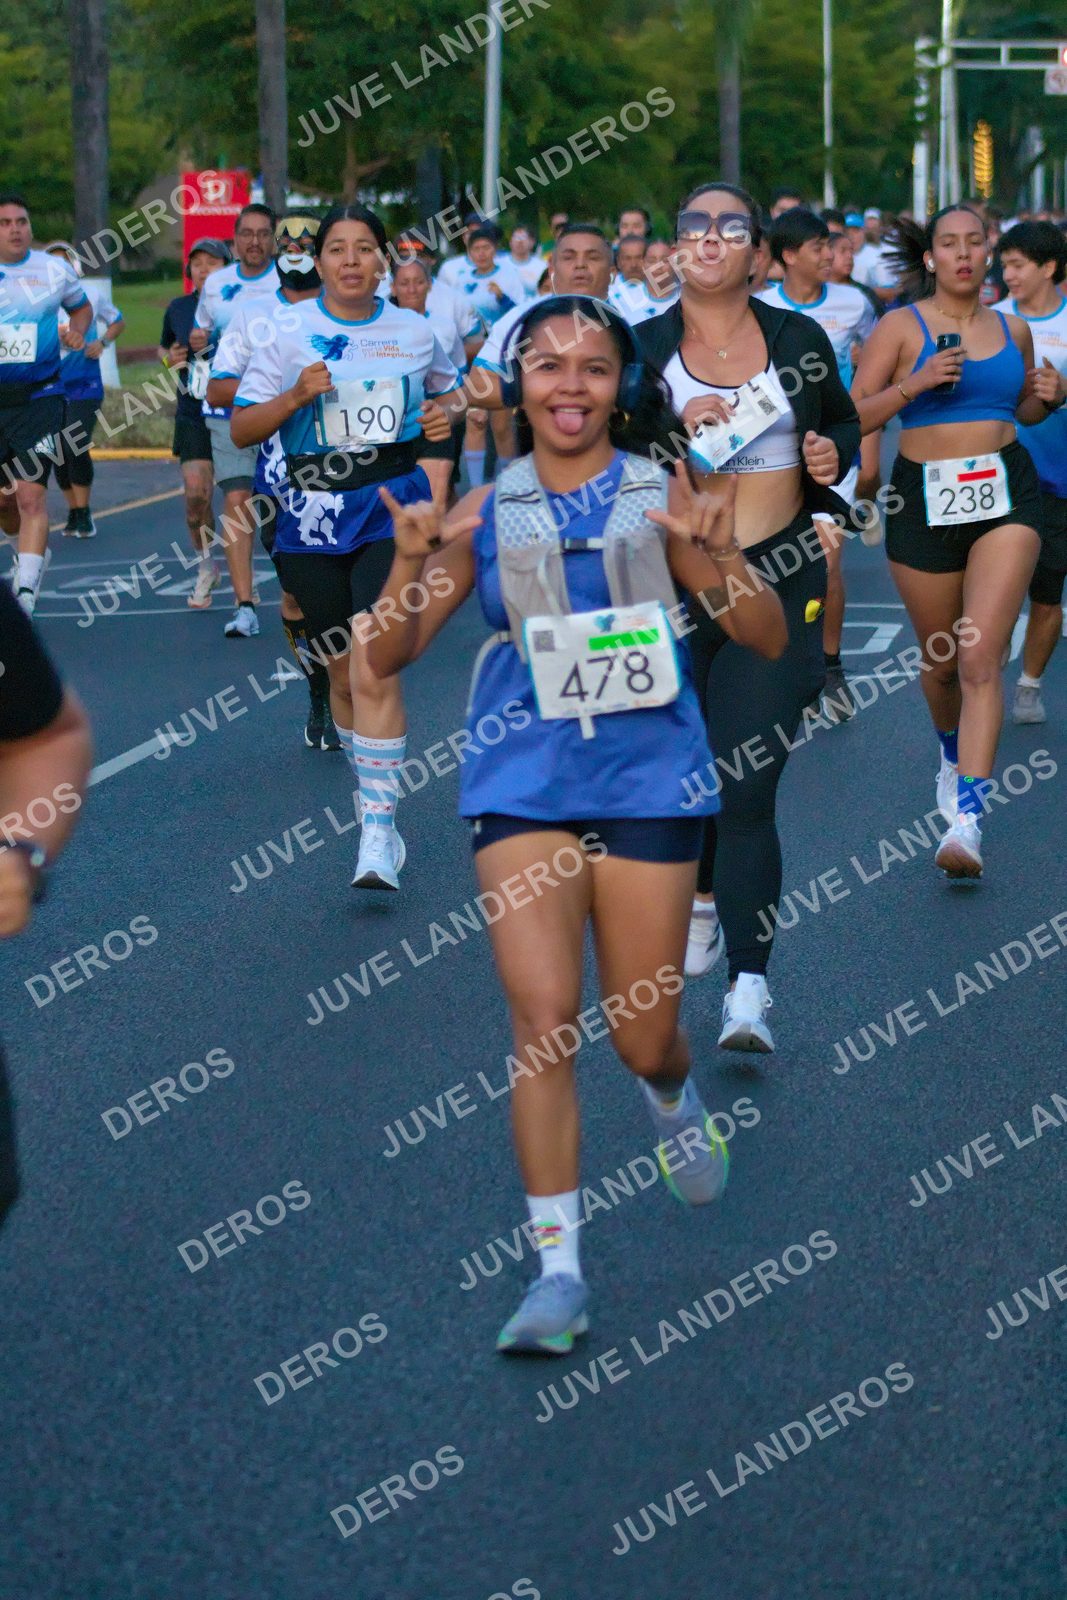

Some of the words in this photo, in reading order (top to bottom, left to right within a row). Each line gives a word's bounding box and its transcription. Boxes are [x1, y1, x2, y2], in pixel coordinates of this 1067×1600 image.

[340, 405, 396, 437] 190
[737, 456, 765, 466] Klein
[939, 482, 995, 516] 238
[559, 651, 654, 702] 478
